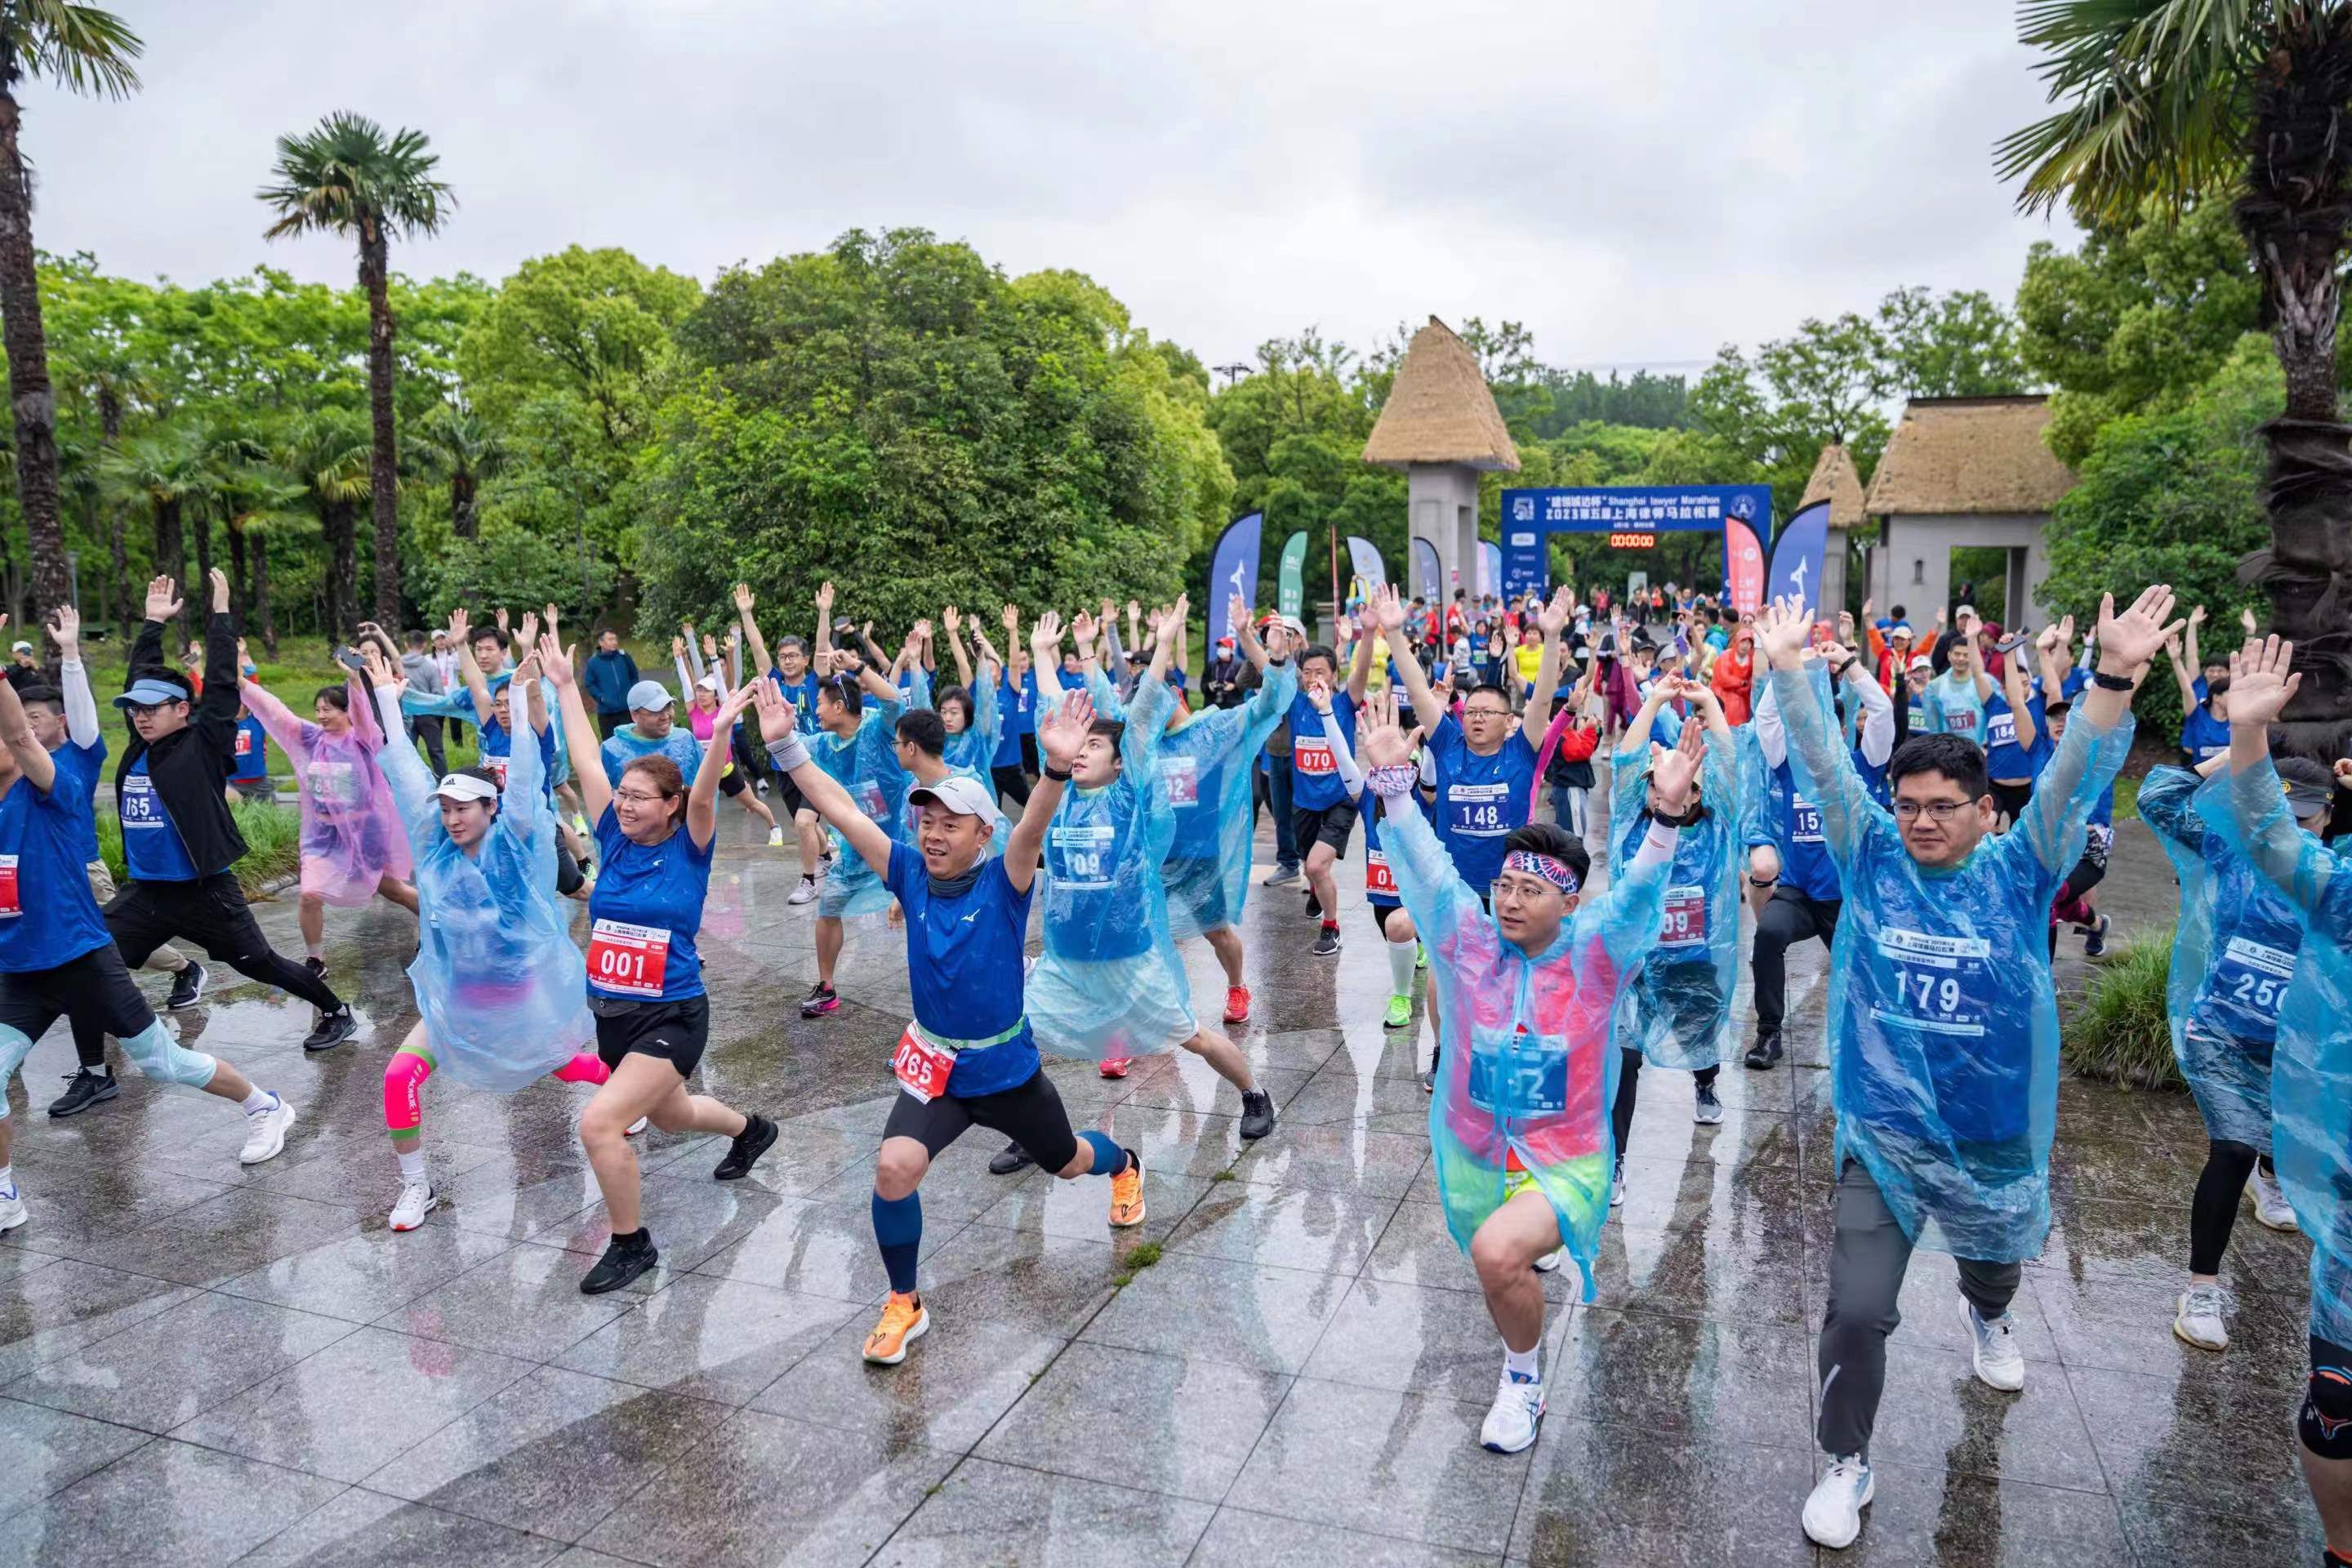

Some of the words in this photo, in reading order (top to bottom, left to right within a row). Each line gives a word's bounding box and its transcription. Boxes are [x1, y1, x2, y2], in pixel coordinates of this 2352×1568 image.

[1608, 496, 1646, 507] Shanghai
[1650, 496, 1677, 507] lawyer
[1681, 496, 1720, 506] Marathon
[1994, 724, 2015, 739] 184
[1303, 752, 1330, 768] 070
[126, 797, 149, 817] 165
[1463, 805, 1498, 826] 148
[1798, 812, 1823, 831] 15
[600, 949, 644, 979] 001
[1895, 970, 1960, 1013] 179
[894, 1044, 933, 1085] 065
